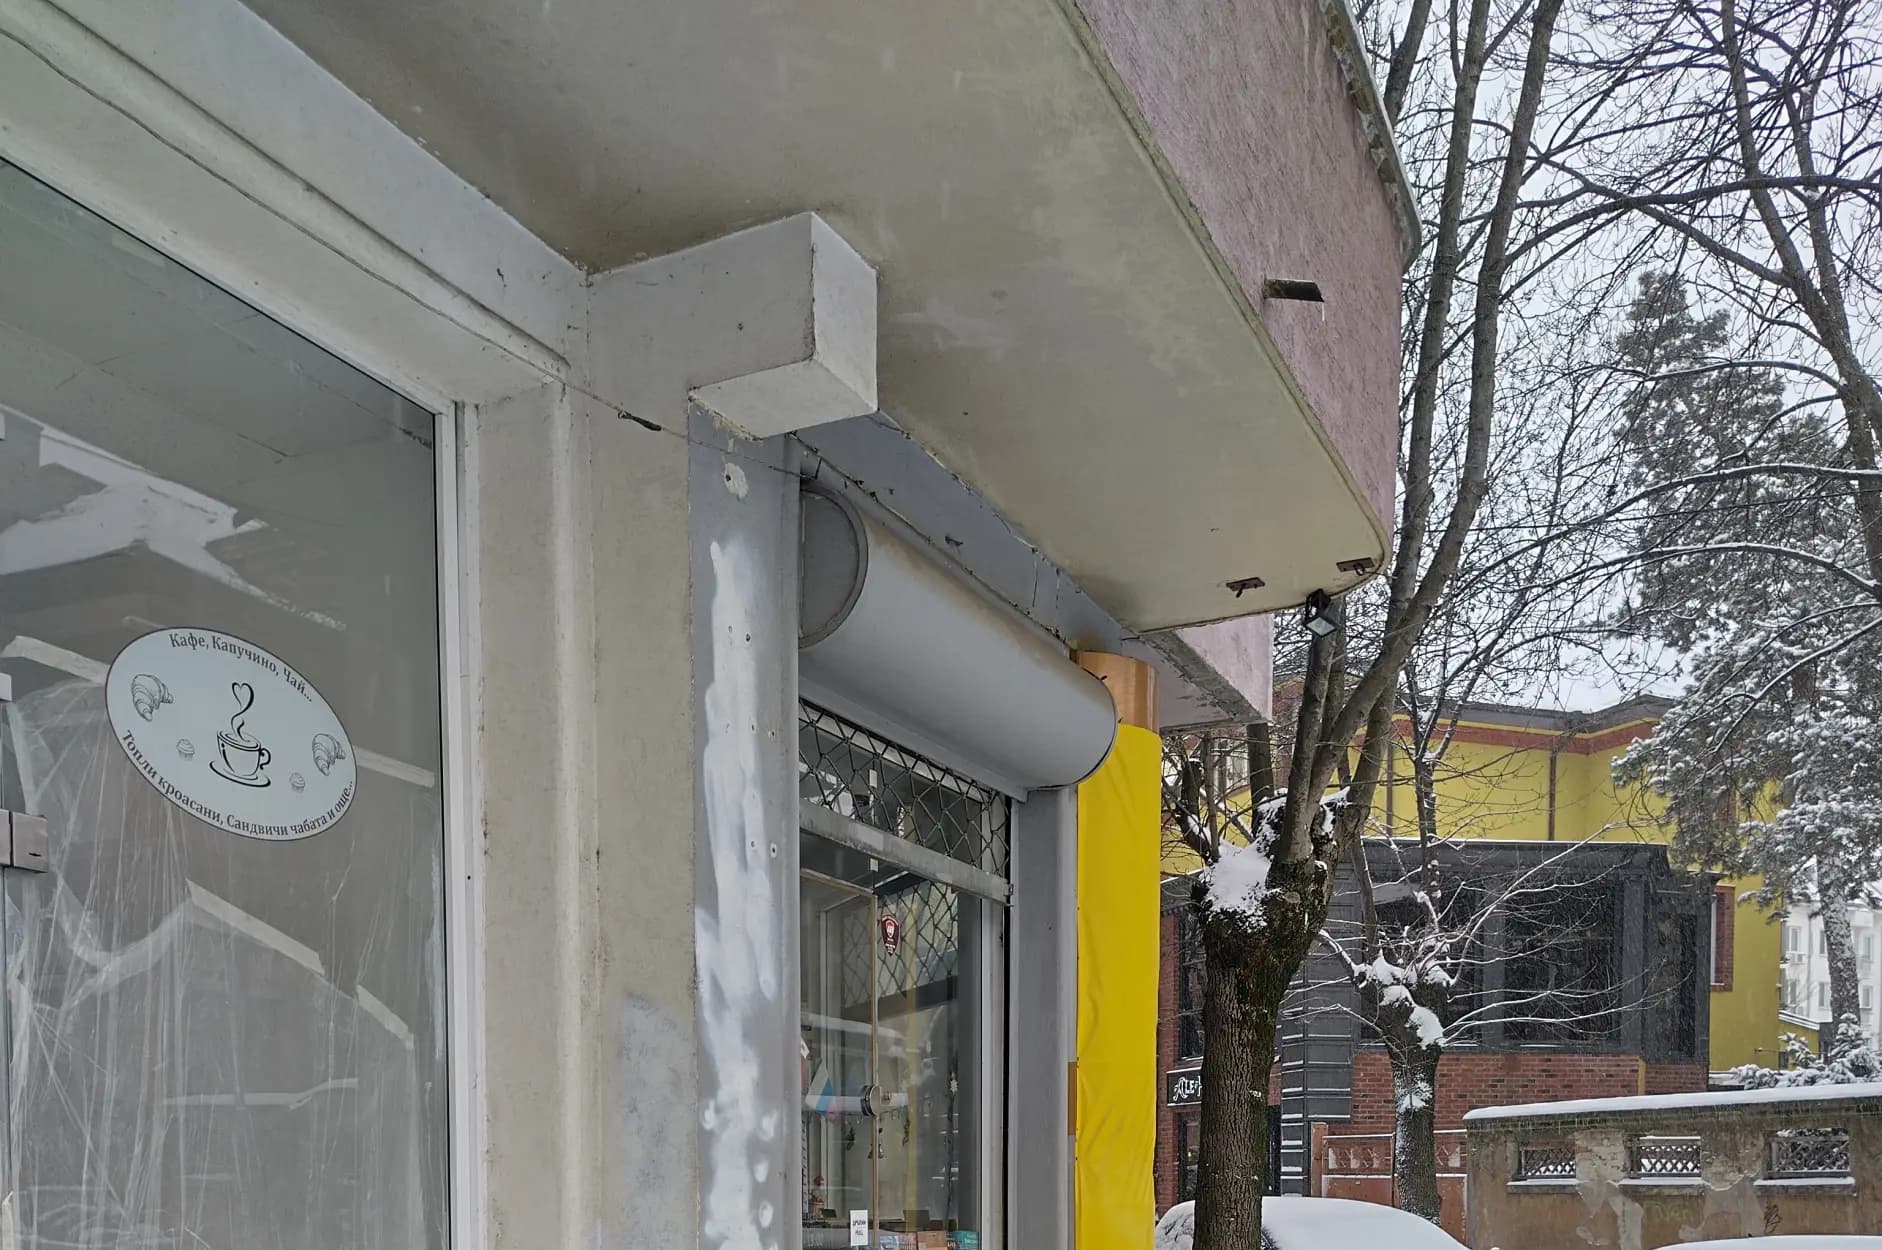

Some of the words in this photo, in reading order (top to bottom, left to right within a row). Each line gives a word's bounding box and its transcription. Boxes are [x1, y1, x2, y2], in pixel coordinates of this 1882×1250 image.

[169, 633, 209, 651] Кафе,
[212, 635, 279, 676] Капучино,
[122, 730, 157, 780] Топли
[158, 778, 224, 826] кроасани,
[227, 814, 288, 836] Сандвичи
[290, 816, 328, 836] чабата
[328, 809, 336, 823] и
